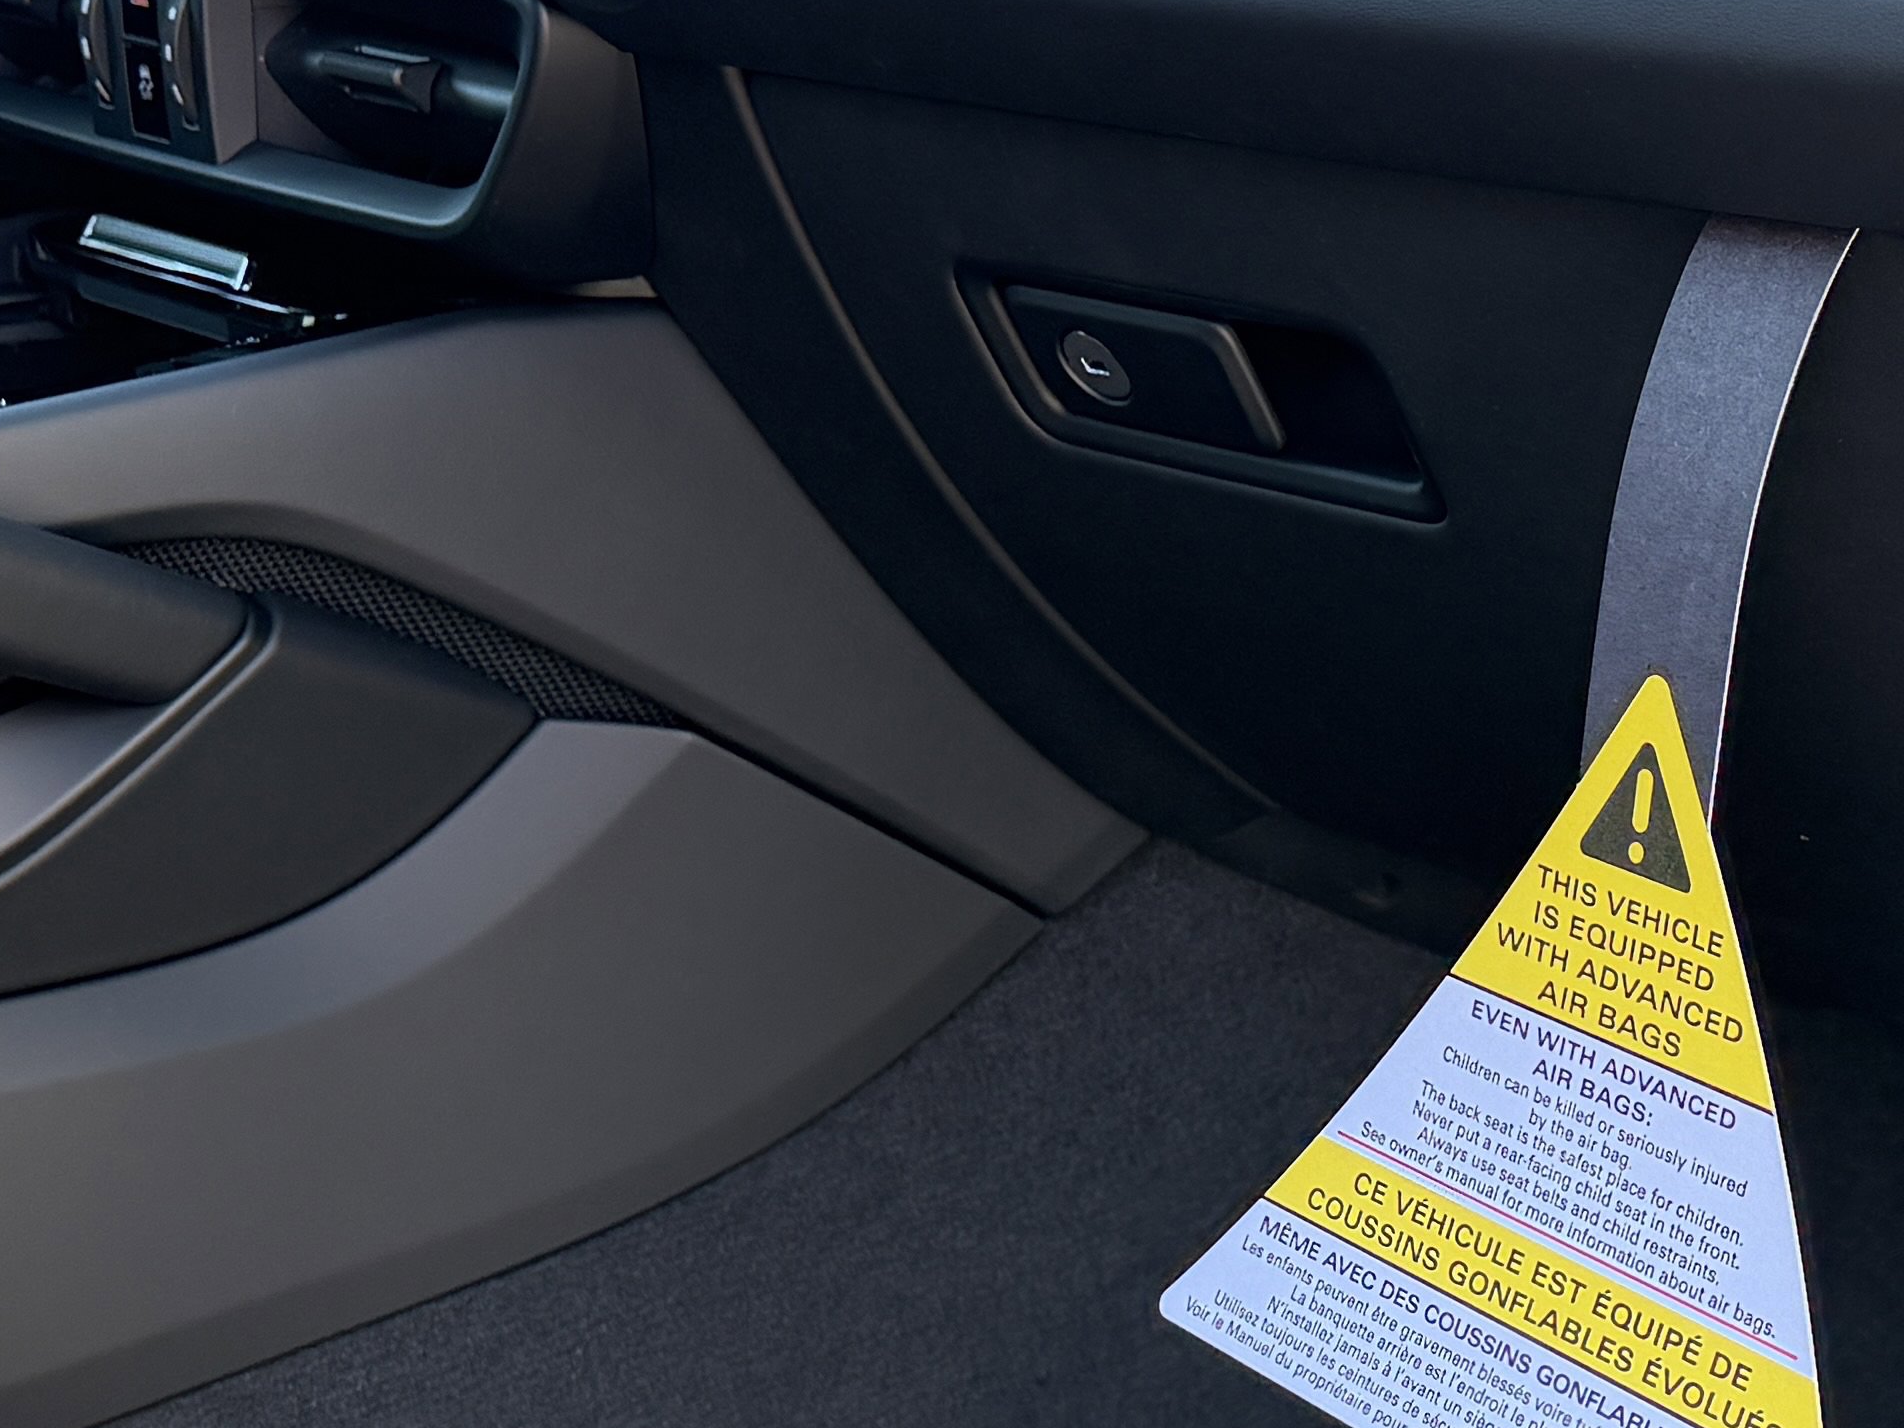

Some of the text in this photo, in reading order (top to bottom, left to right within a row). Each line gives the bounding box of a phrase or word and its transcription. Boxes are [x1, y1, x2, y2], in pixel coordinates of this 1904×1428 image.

[1533, 899, 1714, 991] IS EQUIPPED
[1537, 863, 1724, 957] THIS VEHICLE
[1497, 921, 1742, 1042] WITH ADVANCED
[1537, 980, 1680, 1057] AIR BAGS
[1442, 1045, 1748, 1197] Children can be killed or seriously injured
[1471, 998, 1735, 1129] EVEN WITH ADVANCED
[1531, 1058, 1652, 1126] AIR BAGS:
[1412, 1099, 1454, 1131] Never
[1454, 1124, 1480, 1145] put
[1481, 1136, 1491, 1150] a
[1494, 1142, 1571, 1192] rear-facing
[1574, 1180, 1613, 1207] child
[1614, 1199, 1647, 1225] seat
[1649, 1211, 1664, 1233] in
[1668, 1223, 1694, 1247] the
[1416, 1126, 1468, 1162] Always
[1471, 1154, 1496, 1176] use
[1498, 1168, 1529, 1193] seat
[1531, 1179, 1568, 1211] belts
[1570, 1202, 1601, 1226] and
[1602, 1217, 1641, 1246] child
[1421, 1079, 1445, 1106] The
[1448, 1093, 1481, 1123] back
[1483, 1114, 1514, 1138] seat
[1516, 1124, 1528, 1144] is
[1532, 1134, 1555, 1157] the
[1559, 1149, 1603, 1180] safest
[1604, 1167, 1646, 1200] place
[1650, 1187, 1673, 1211] for
[1528, 1107, 1547, 1131] by
[1550, 1119, 1574, 1142] the
[1577, 1134, 1598, 1151] air
[1307, 1187, 1440, 1270] COUSSINS
[1448, 1260, 1634, 1372] GONFLABLES
[1360, 1120, 1386, 1146] See
[1445, 1165, 1500, 1201] manual
[1501, 1188, 1523, 1213] for
[1523, 1204, 1564, 1233] more
[1658, 1269, 1704, 1303] about
[1707, 1294, 1730, 1314] air
[1186, 1294, 1210, 1321] Voir
[1210, 1311, 1224, 1330] le
[1224, 1319, 1275, 1358] Manuel
[1274, 1349, 1293, 1370] du
[1241, 1233, 1264, 1258] Les
[1266, 1252, 1313, 1285] enfants
[1313, 1278, 1369, 1316] peuvent
[1398, 1325, 1476, 1375] gravement
[1535, 1397, 1572, 1427] voire
[1258, 1215, 1321, 1261] MÊME
[1321, 1251, 1376, 1290] AVEC
[1378, 1279, 1420, 1313] DES
[1423, 1303, 1532, 1374] COUSSINS
[1353, 1172, 1752, 1391] CE VÉHICULE EST ÉQUIPÉ DE
[1260, 1317, 1314, 1358] toujours
[1315, 1346, 1336, 1370] les
[1337, 1363, 1400, 1406] ceintures
[1401, 1398, 1420, 1418] de
[1290, 1283, 1306, 1306] La
[1307, 1292, 1374, 1343] banquette
[1424, 1363, 1446, 1384] est
[1509, 1406, 1524, 1427] le
[1332, 1333, 1380, 1370] jamais
[1442, 1397, 1462, 1417] un
